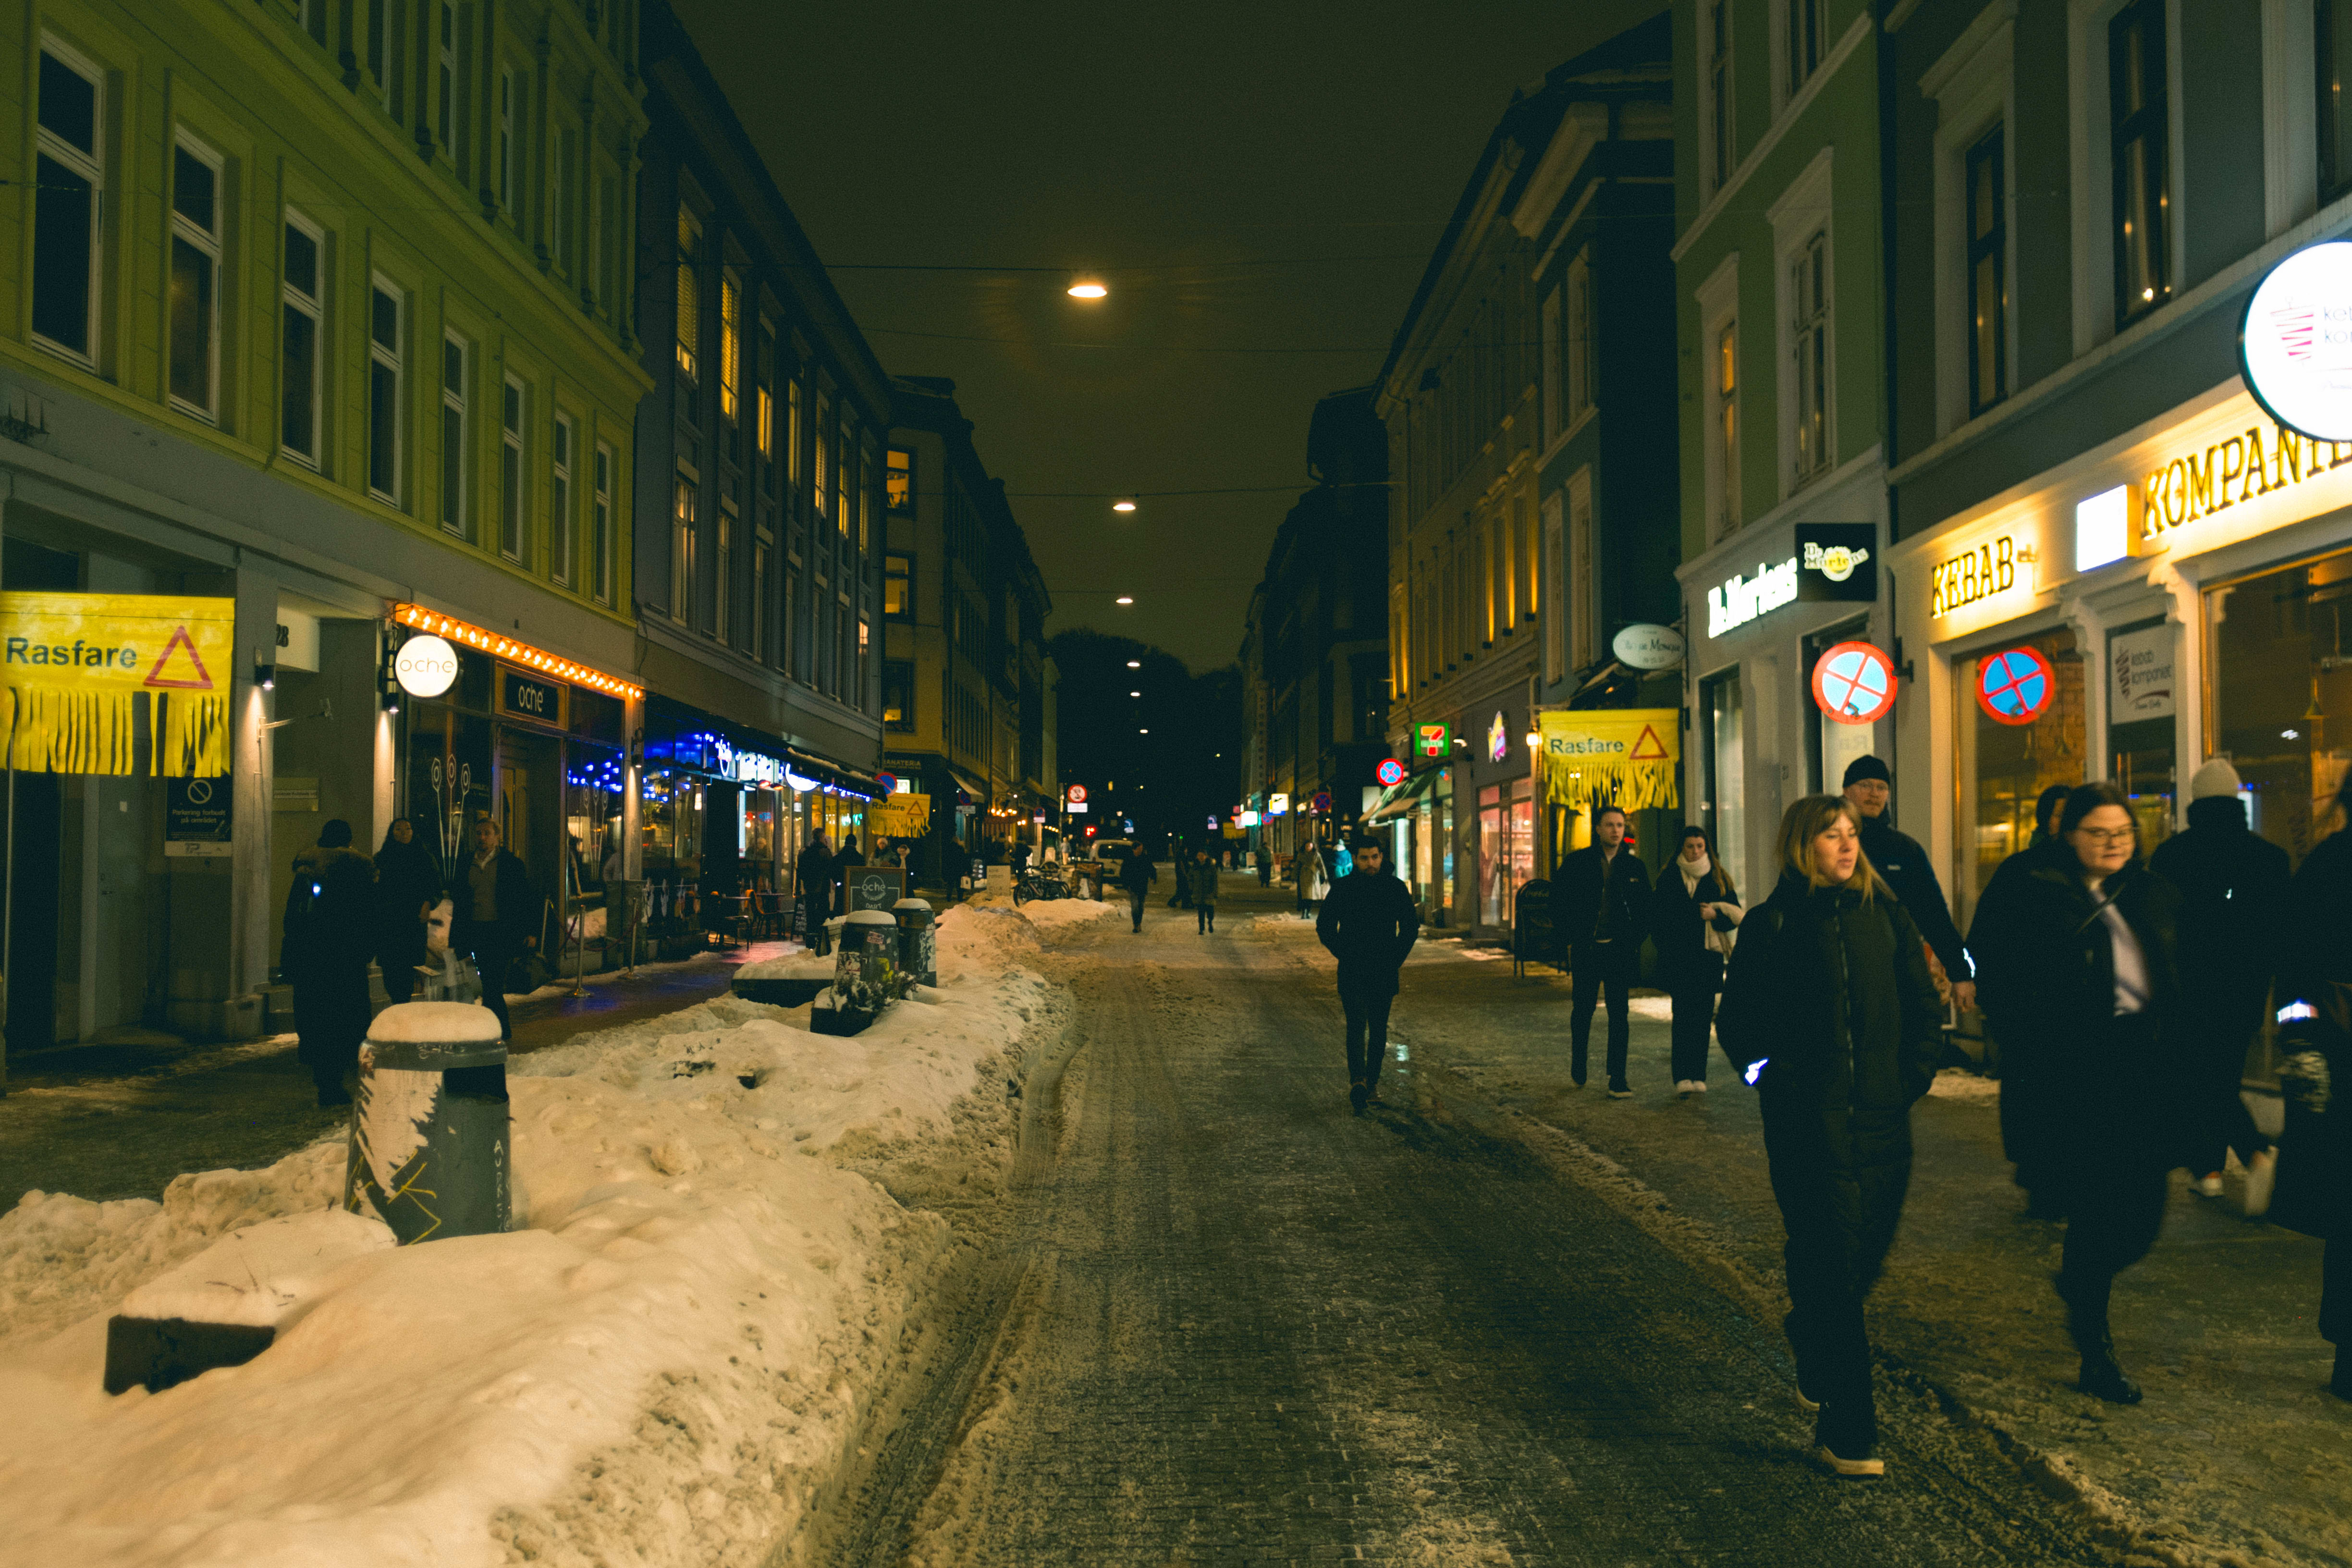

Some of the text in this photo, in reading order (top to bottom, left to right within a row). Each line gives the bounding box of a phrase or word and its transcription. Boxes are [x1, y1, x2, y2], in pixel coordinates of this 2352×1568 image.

[1931, 535, 2014, 618] KEBAB
[6, 637, 137, 668] Rasfare
[400, 657, 454, 673] oche
[519, 684, 543, 712] oche
[1550, 738, 1623, 753] Rasfare
[872, 802, 905, 811] Rasfare
[862, 882, 886, 892] oche
